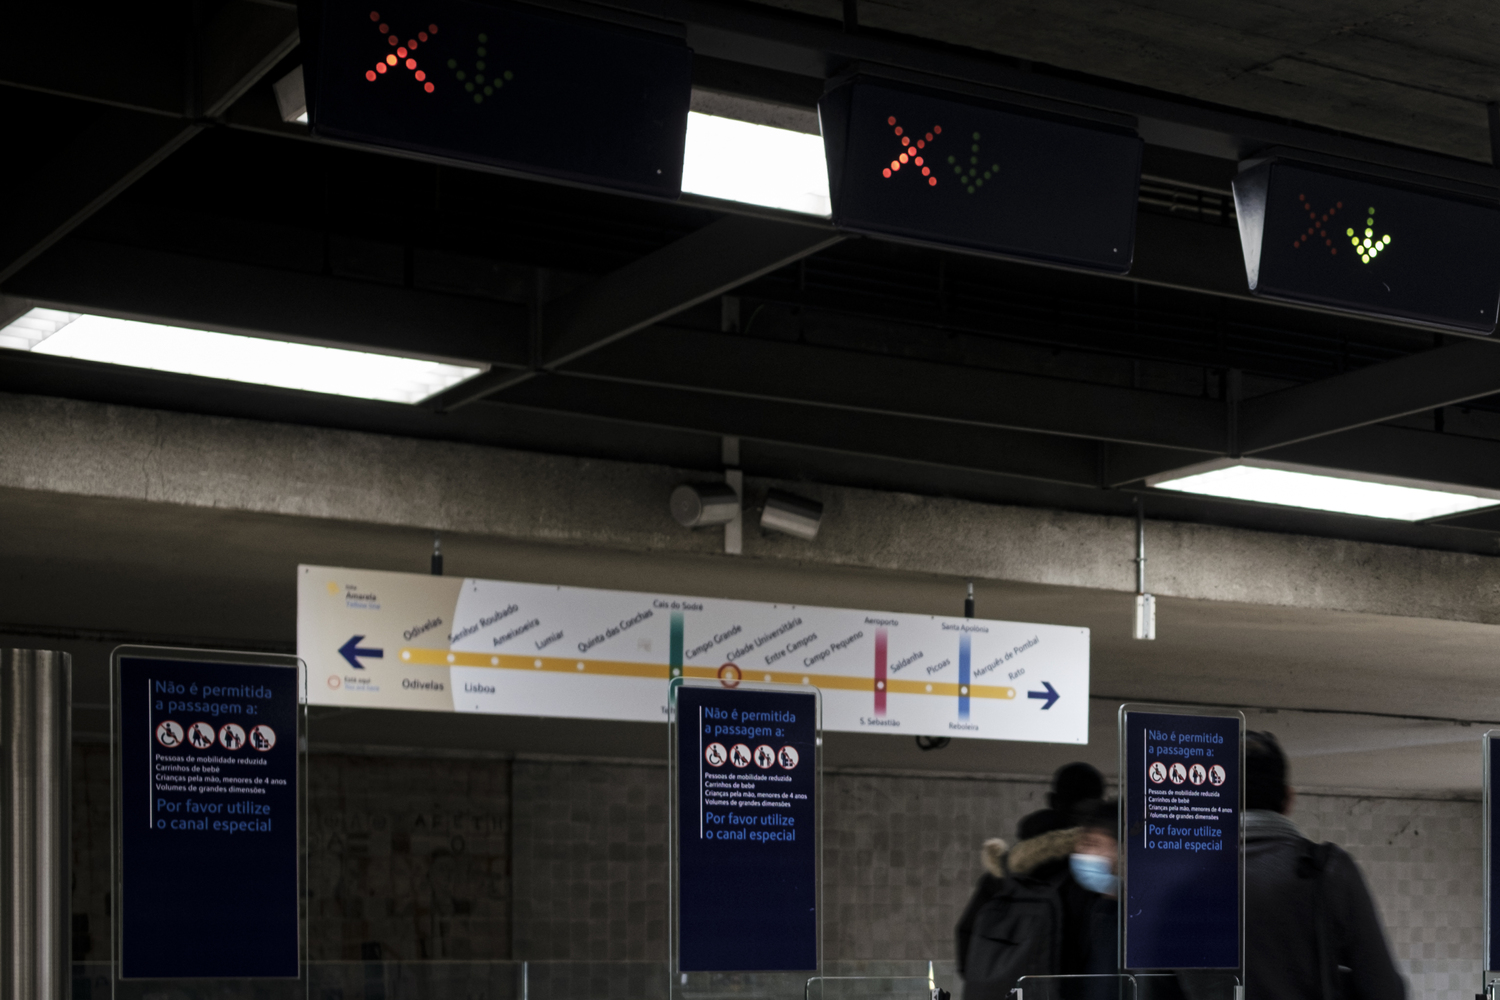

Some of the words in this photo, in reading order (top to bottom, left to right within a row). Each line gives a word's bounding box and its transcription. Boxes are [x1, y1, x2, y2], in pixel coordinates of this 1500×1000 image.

[653, 600, 668, 608] Cais
[682, 602, 703, 611] Sodré
[448, 623, 479, 643] Senhor
[479, 603, 519, 628] Roubado
[864, 617, 898, 626] Aeroporto
[942, 623, 959, 631] Santa
[961, 624, 989, 633] Apolónia
[403, 617, 442, 641] Odivelas
[493, 618, 540, 646] Ameixoeira
[578, 635, 605, 653] Quinta
[606, 627, 620, 638] das
[620, 609, 653, 630] Conchas
[535, 630, 564, 650] Lumiar
[686, 641, 713, 659] Campo
[714, 624, 742, 644] Grande
[726, 644, 754, 662] Cidade
[754, 617, 802, 647] Universitária
[765, 651, 785, 665] Entre
[786, 632, 817, 653] Campos
[804, 649, 830, 667] Campo
[830, 631, 863, 652] Pequeno
[890, 651, 924, 674] Saldanha
[973, 657, 1004, 678] Marquês
[1004, 651, 1014, 660] de
[1014, 636, 1039, 655] Pombal
[926, 658, 950, 675] Picoas
[1008, 667, 1025, 681] Rato
[155, 680, 185, 695] Não
[190, 682, 198, 695] é
[202, 684, 272, 699] permitida
[402, 678, 444, 691] Odivelas
[465, 683, 495, 693] Lisboa
[155, 700, 163, 710] a
[168, 701, 242, 716] passagem
[246, 704, 258, 715] a:
[705, 707, 728, 720] Não
[732, 709, 738, 720] é
[742, 710, 796, 723] permitida
[868, 718, 900, 726] Sebastião
[949, 722, 978, 731] Reboleira
[705, 725, 711, 734] a
[715, 724, 772, 738] passagem
[775, 728, 784, 737] a:
[1149, 730, 1167, 741] Não
[1171, 731, 1176, 741] é
[1179, 733, 1223, 744] permitida
[1157, 746, 1204, 758] passagem
[156, 754, 185, 762] Pessoas
[197, 756, 235, 764] mobilidade
[237, 757, 267, 765] reduzida
[156, 764, 190, 772] Carrinhos
[202, 765, 220, 773] bebé
[156, 774, 186, 783] Crianças
[188, 775, 203, 784] pela
[205, 776, 221, 784] mão,
[156, 783, 186, 792] Volumes
[188, 784, 197, 792] de
[199, 785, 226, 794] grandes
[228, 785, 265, 794] dimensões
[157, 798, 182, 813] Por
[186, 799, 223, 813] favor
[227, 801, 270, 815] utilize
[157, 819, 166, 829] o
[171, 817, 208, 830] canal
[213, 818, 271, 834] especial
[706, 812, 725, 824] Por
[728, 812, 757, 825] favor
[760, 814, 794, 826] utilize
[706, 831, 713, 839] o
[716, 828, 746, 840] canal
[749, 829, 795, 843] especial
[1149, 824, 1165, 835] Por
[1168, 825, 1191, 836] favor
[1194, 826, 1222, 837] utilize
[1158, 839, 1182, 849] canal
[1185, 840, 1222, 852] especial
